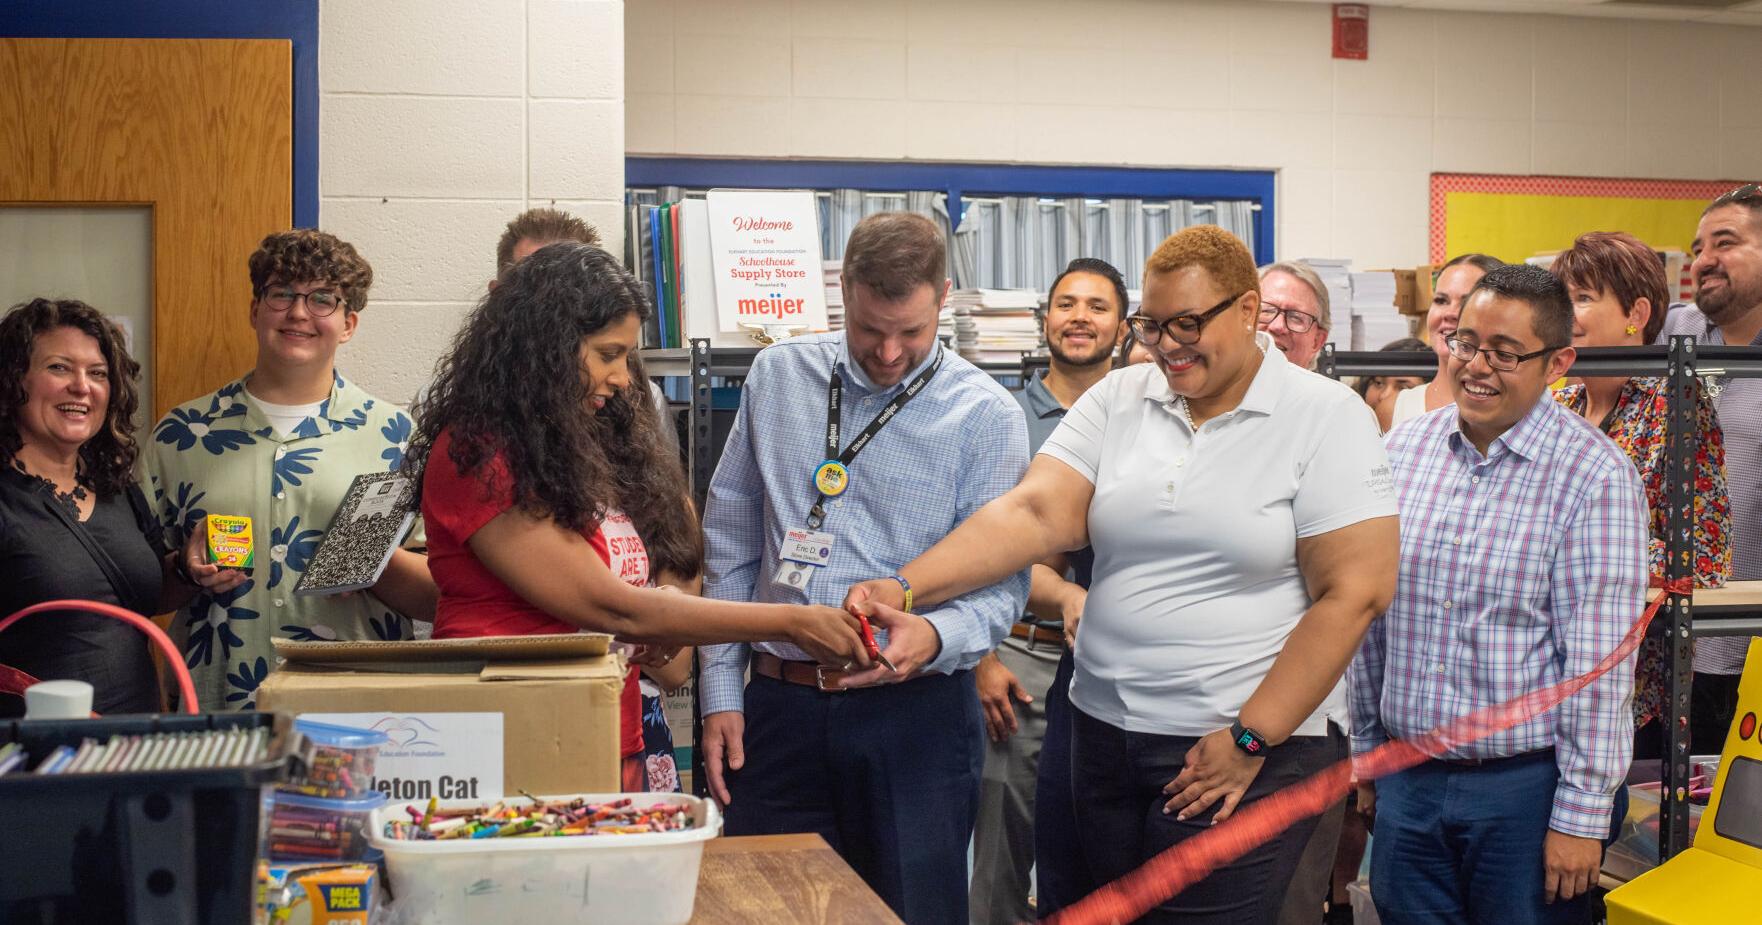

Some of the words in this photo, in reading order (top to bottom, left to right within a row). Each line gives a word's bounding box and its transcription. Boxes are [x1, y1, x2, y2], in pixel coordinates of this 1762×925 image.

[732, 216, 793, 231] Welcome
[739, 257, 795, 266] Schoolhouse
[731, 269, 771, 280] Supply
[775, 269, 806, 278] Store
[738, 293, 804, 319] meijer
[907, 378, 925, 396] Elkhart
[878, 403, 899, 425] meijer
[828, 424, 839, 448] meijer
[852, 433, 870, 453] Elkhart
[826, 467, 843, 478] ask
[214, 517, 245, 525] Crayola
[215, 545, 248, 555] CRAYONS
[796, 543, 809, 552] Eric
[620, 557, 641, 577] ARE
[667, 701, 688, 710] View
[439, 775, 479, 800] Cat
[330, 887, 360, 898] MEGA
[330, 897, 360, 909] PACK
